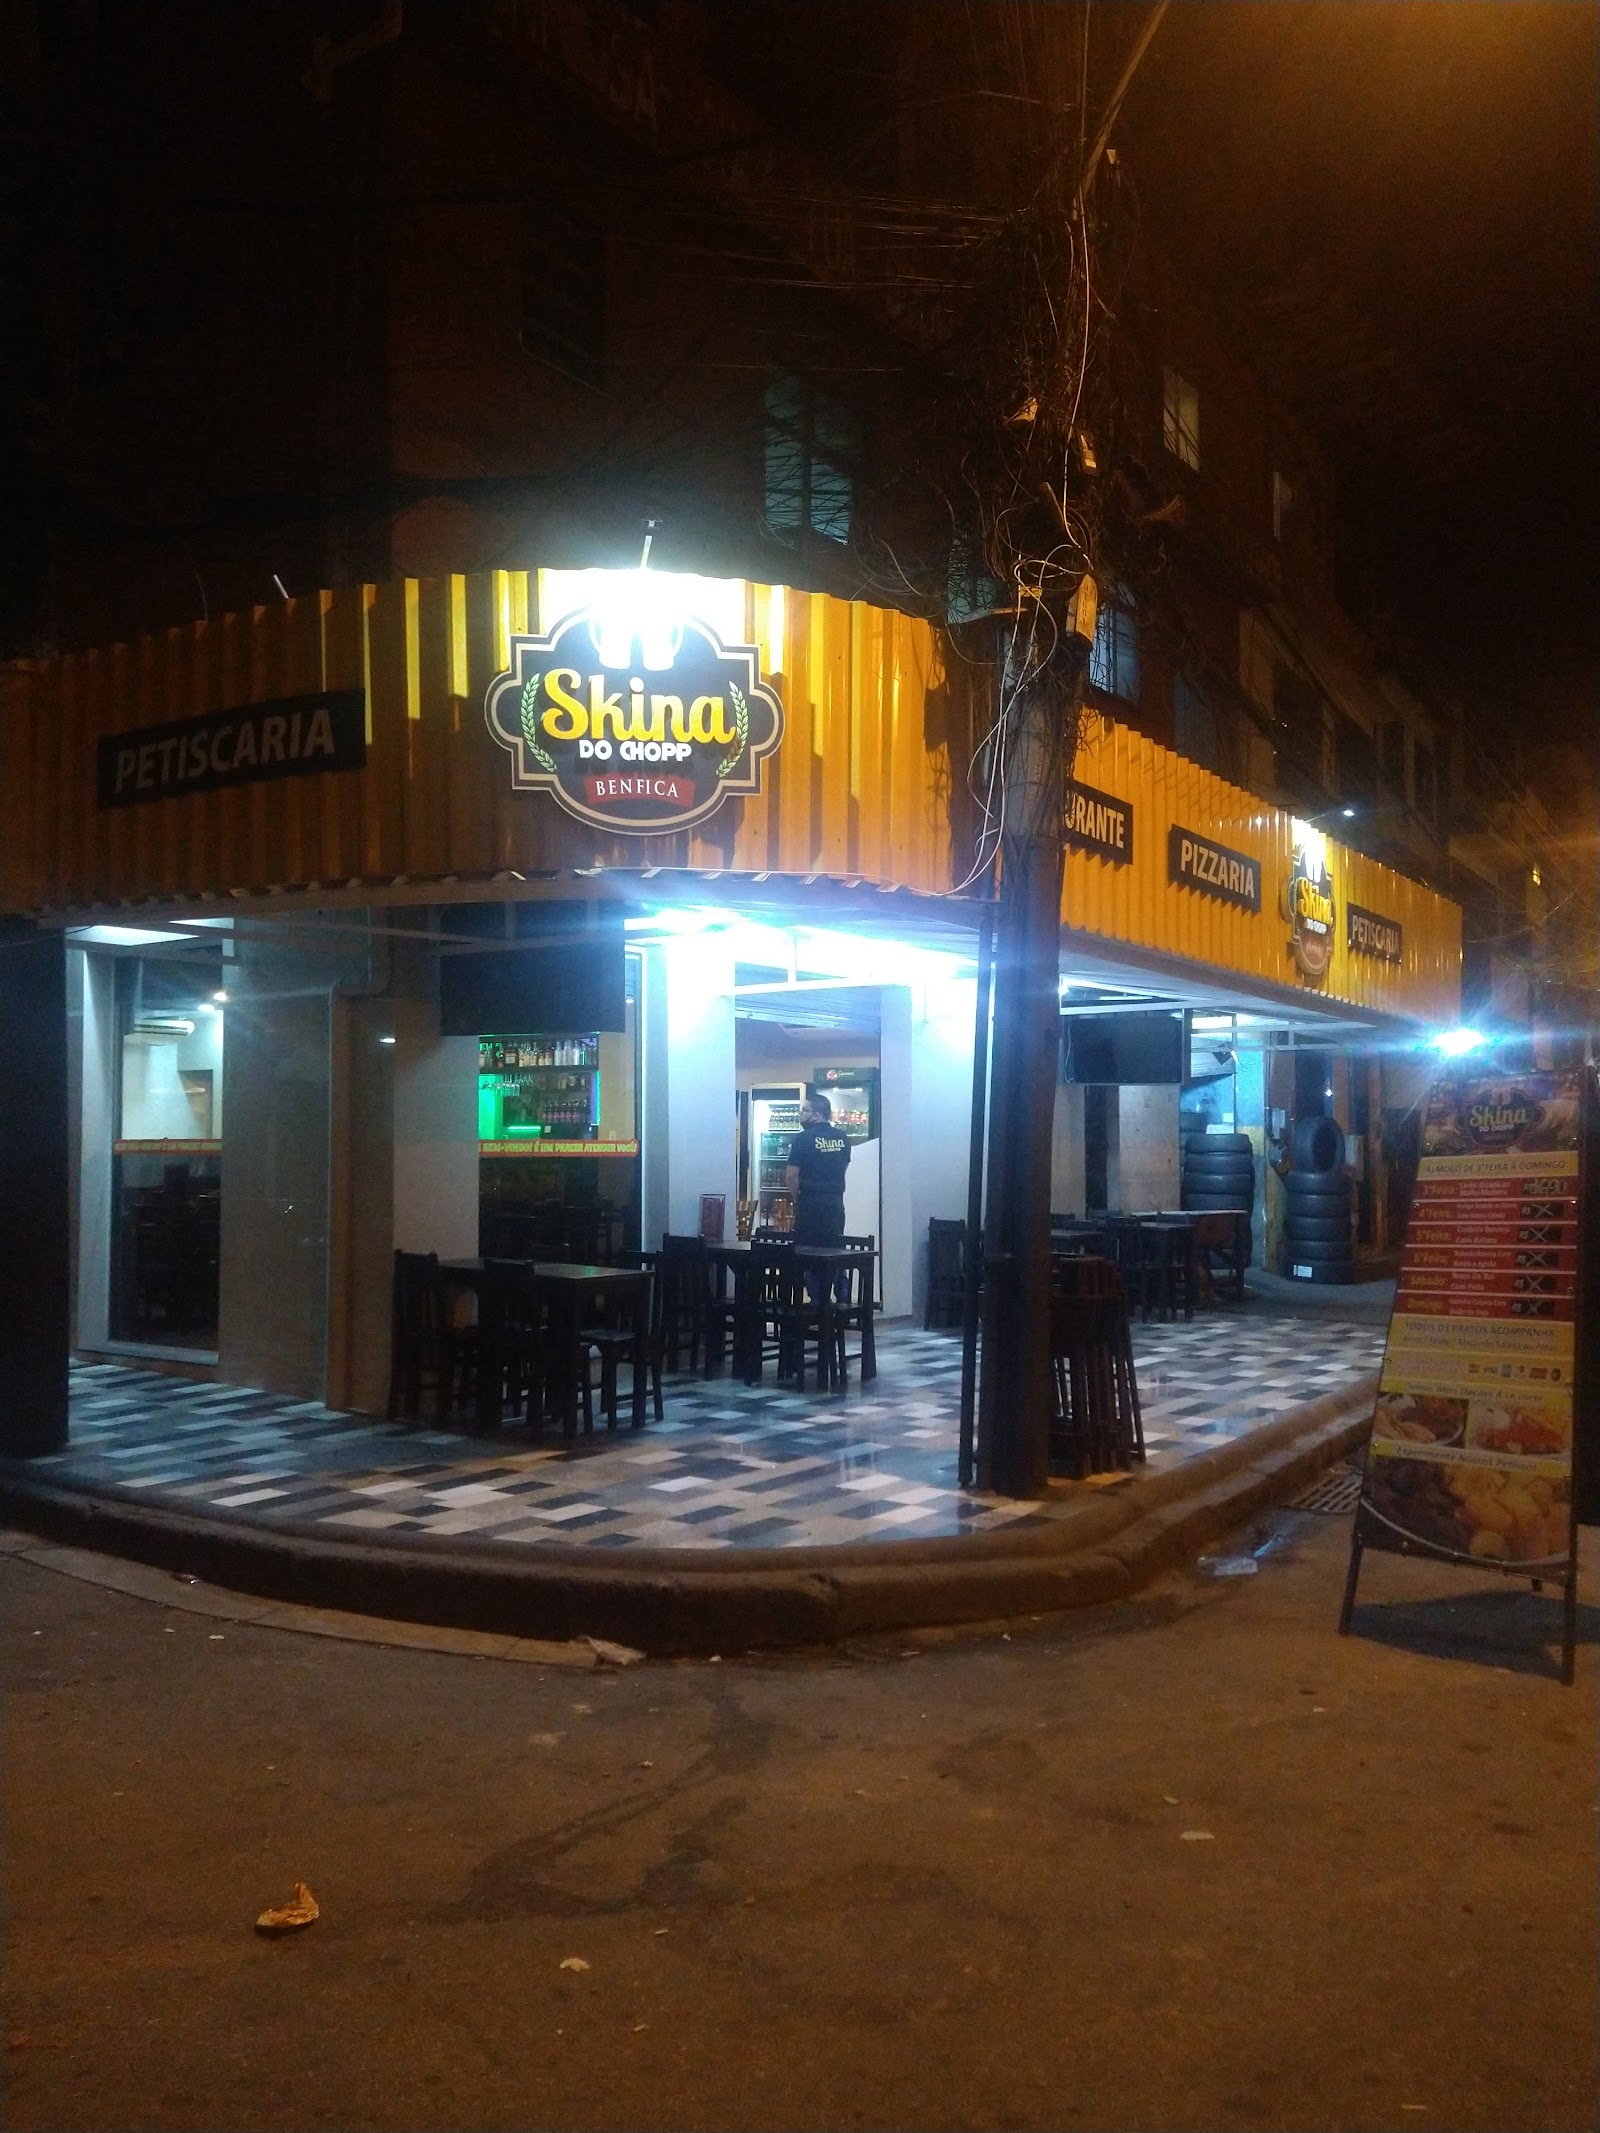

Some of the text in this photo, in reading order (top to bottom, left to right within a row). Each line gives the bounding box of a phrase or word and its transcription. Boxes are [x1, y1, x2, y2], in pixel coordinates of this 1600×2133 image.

[541, 668, 736, 744] Skina
[114, 708, 336, 795] PETISCARIA
[579, 739, 692, 762] DO CHOPP
[595, 778, 679, 798] BENFICA
[1180, 839, 1255, 899] PIZZARIA
[1299, 878, 1333, 926] Skina
[1469, 1105, 1528, 1127] Skina
[815, 1136, 846, 1150] Skina
[1520, 1159, 1566, 1171] DOMINGO
[1406, 1322, 1434, 1332] TODOS
[1452, 1324, 1488, 1334] PRATOS
